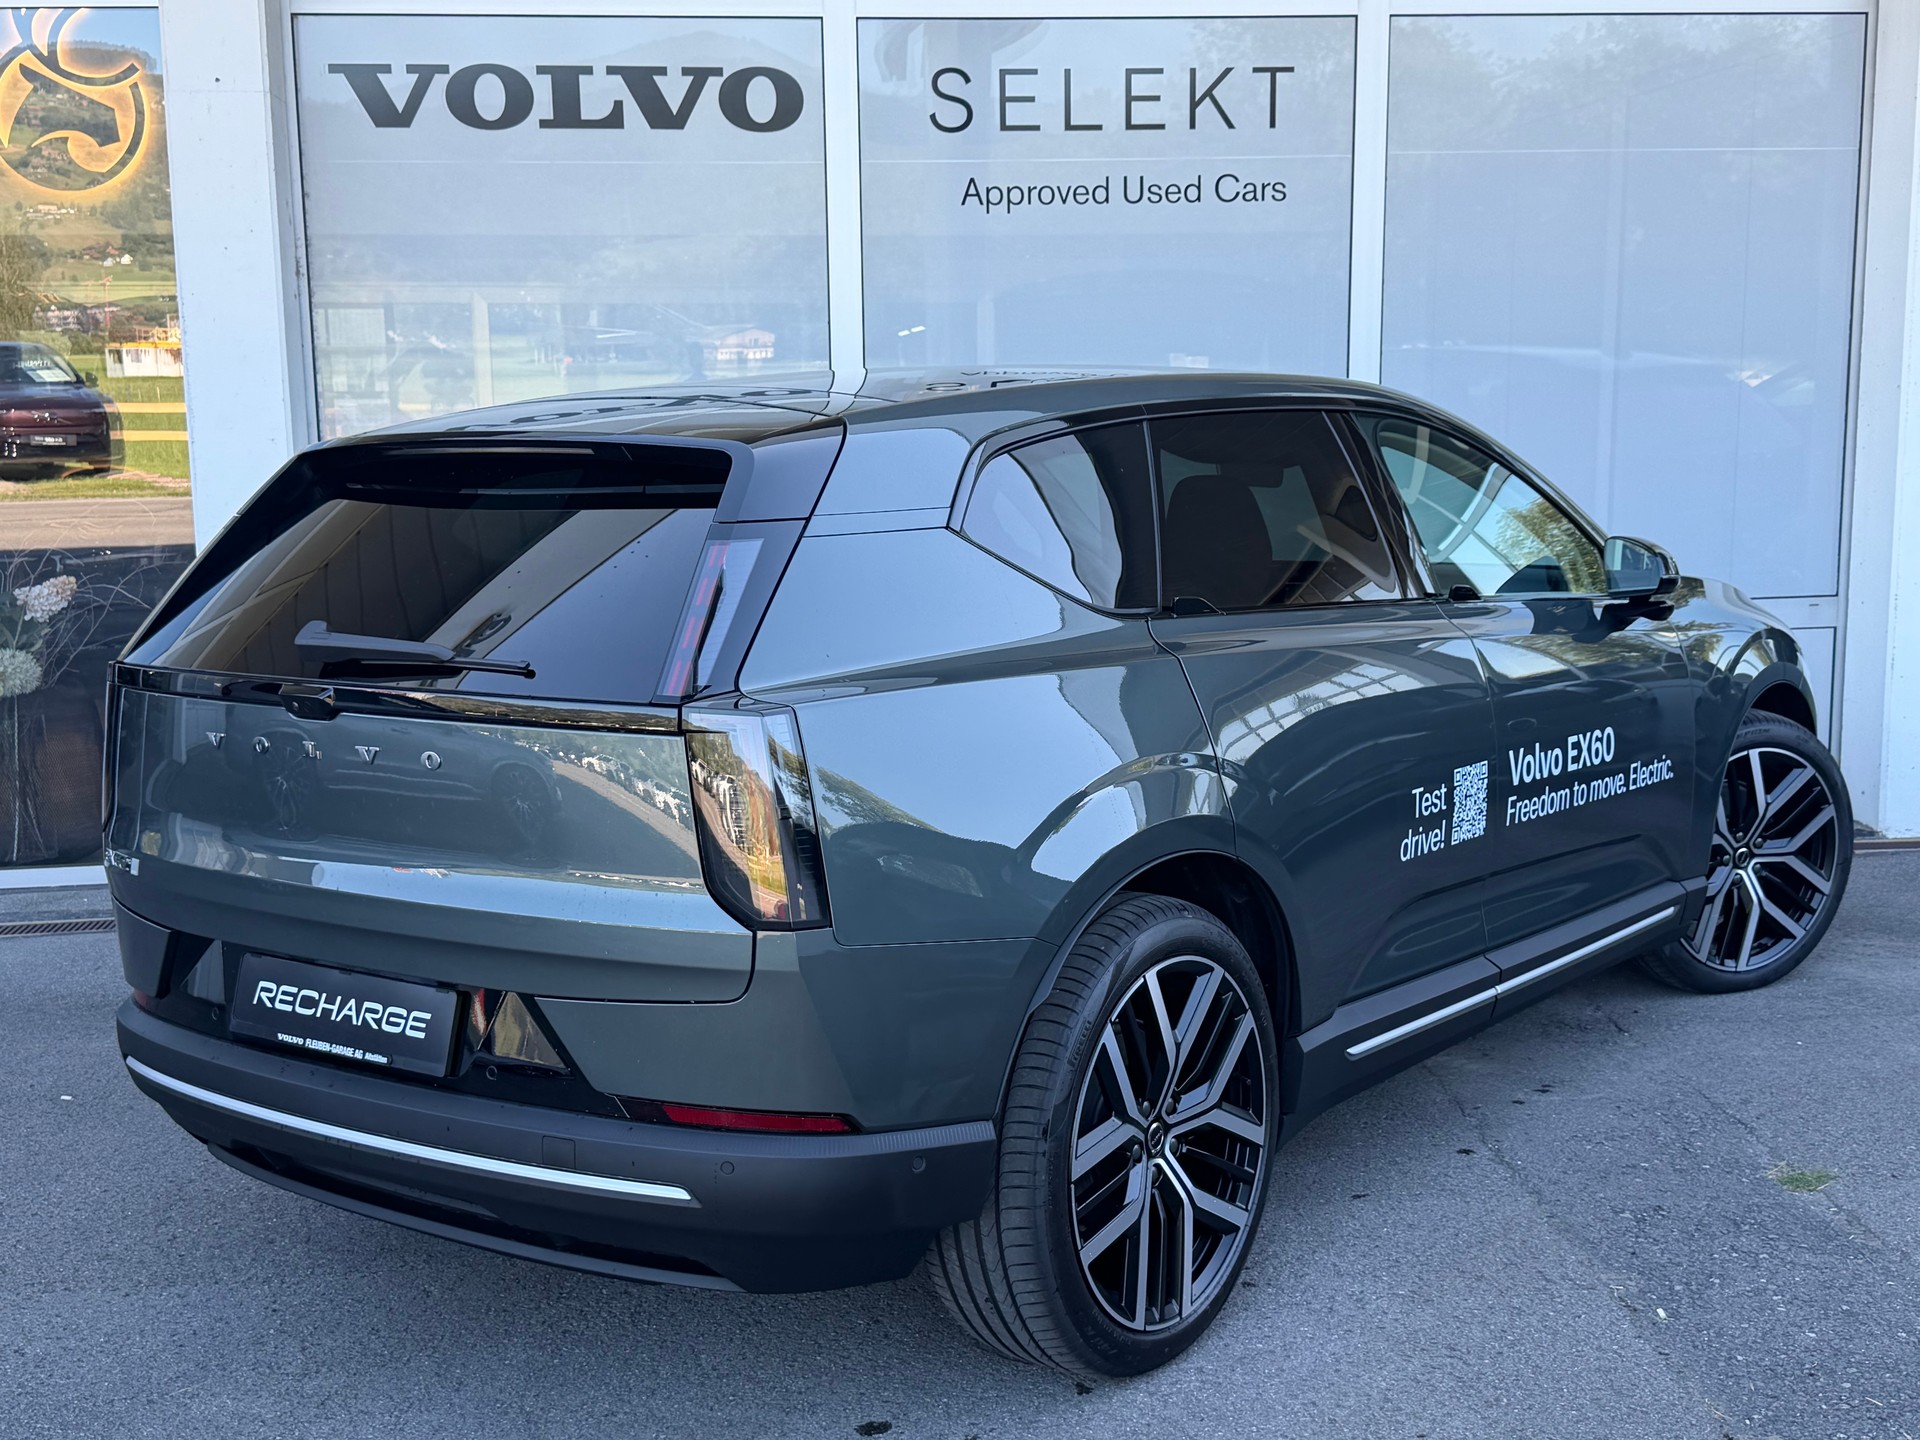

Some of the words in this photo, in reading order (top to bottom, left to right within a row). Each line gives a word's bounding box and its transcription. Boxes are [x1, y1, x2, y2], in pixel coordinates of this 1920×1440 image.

[327, 62, 804, 133] VOLVO
[929, 66, 1295, 133] SELEKT
[961, 176, 1110, 214] Approved
[1123, 174, 1202, 205] Used
[1214, 174, 1288, 203] Cars
[205, 731, 442, 771] VOLVO
[1508, 743, 1563, 786] Volvo
[1567, 726, 1615, 772] EX60
[1411, 783, 1448, 819] Test
[1505, 785, 1570, 827] Freedom
[1573, 779, 1588, 808] to
[1589, 773, 1627, 803] move.
[1629, 754, 1674, 792] Electric.
[1400, 820, 1447, 863] drive!
[252, 980, 432, 1039] RECHARGE
[277, 1032, 304, 1046] VOLVO
[354, 1049, 364, 1060] AG
